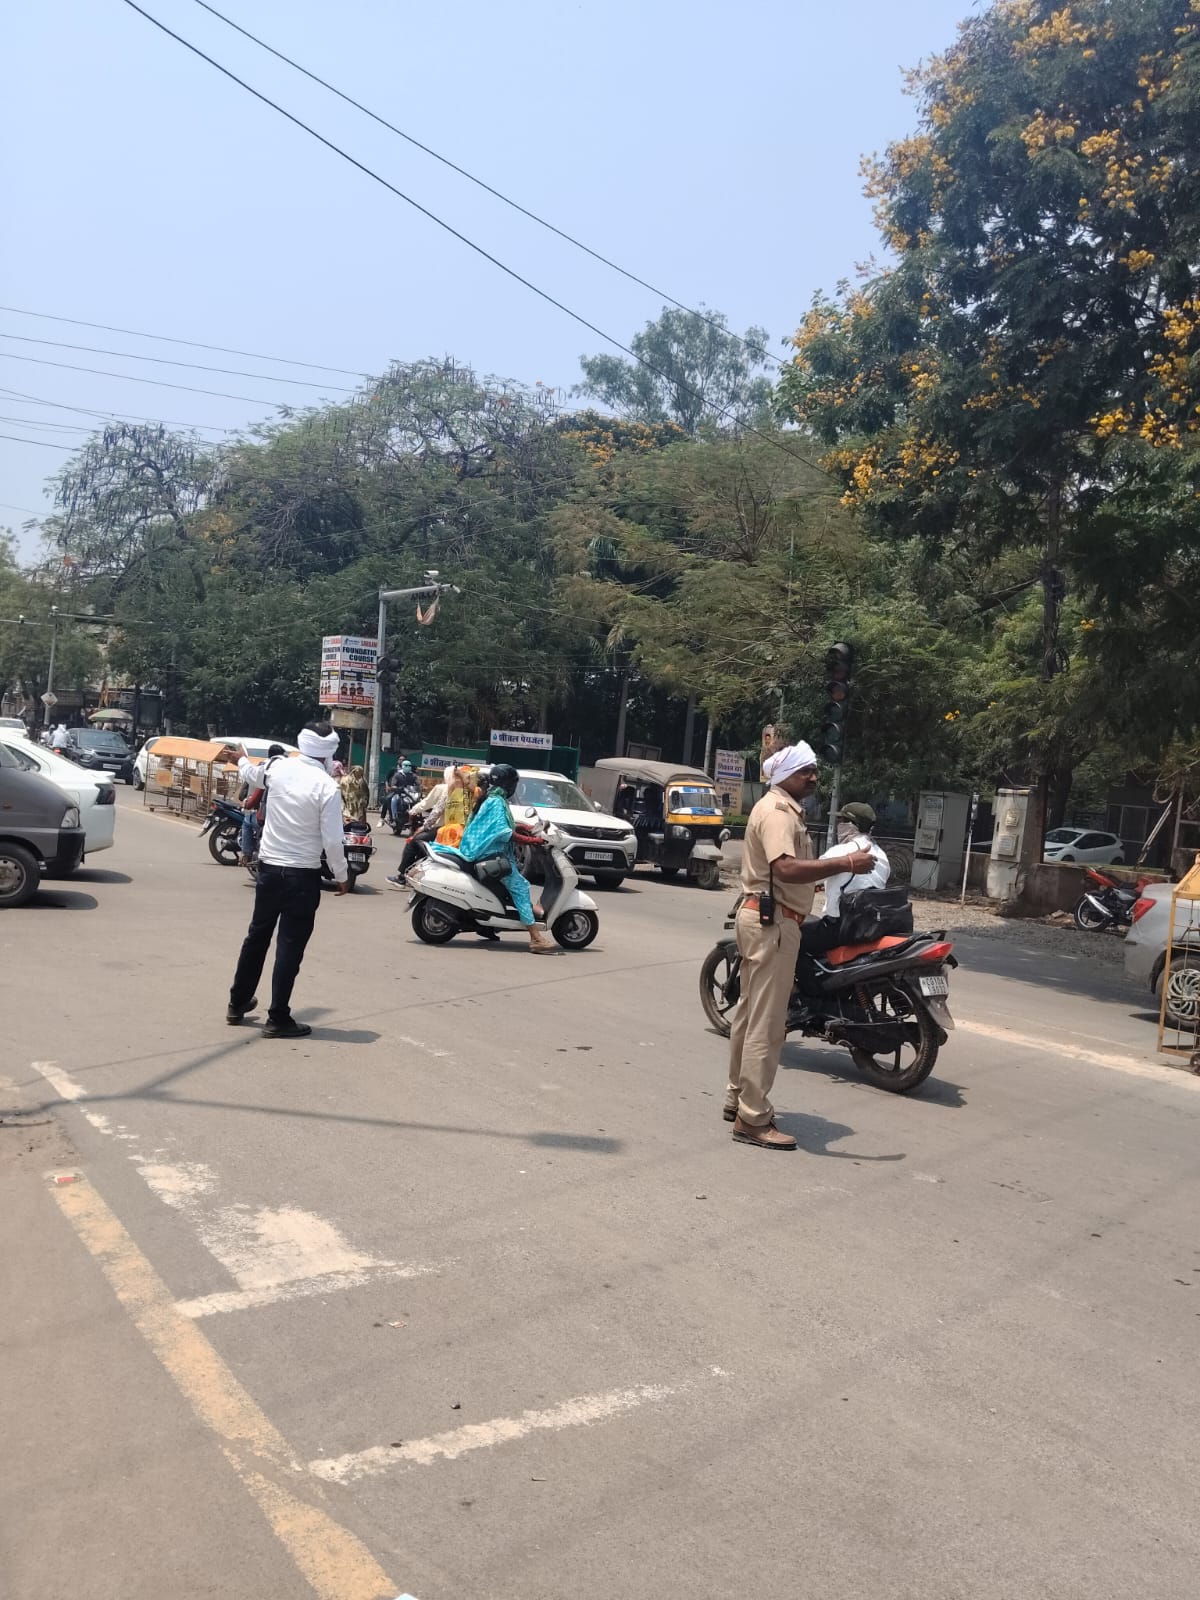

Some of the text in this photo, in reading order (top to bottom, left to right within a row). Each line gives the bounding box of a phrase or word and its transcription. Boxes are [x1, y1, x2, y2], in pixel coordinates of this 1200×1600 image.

[342, 646, 377, 656] FOUNDATIO
[349, 654, 374, 662] COURSE
[498, 733, 545, 744] शीतल पेयजल
[430, 758, 451, 767] शीतल
